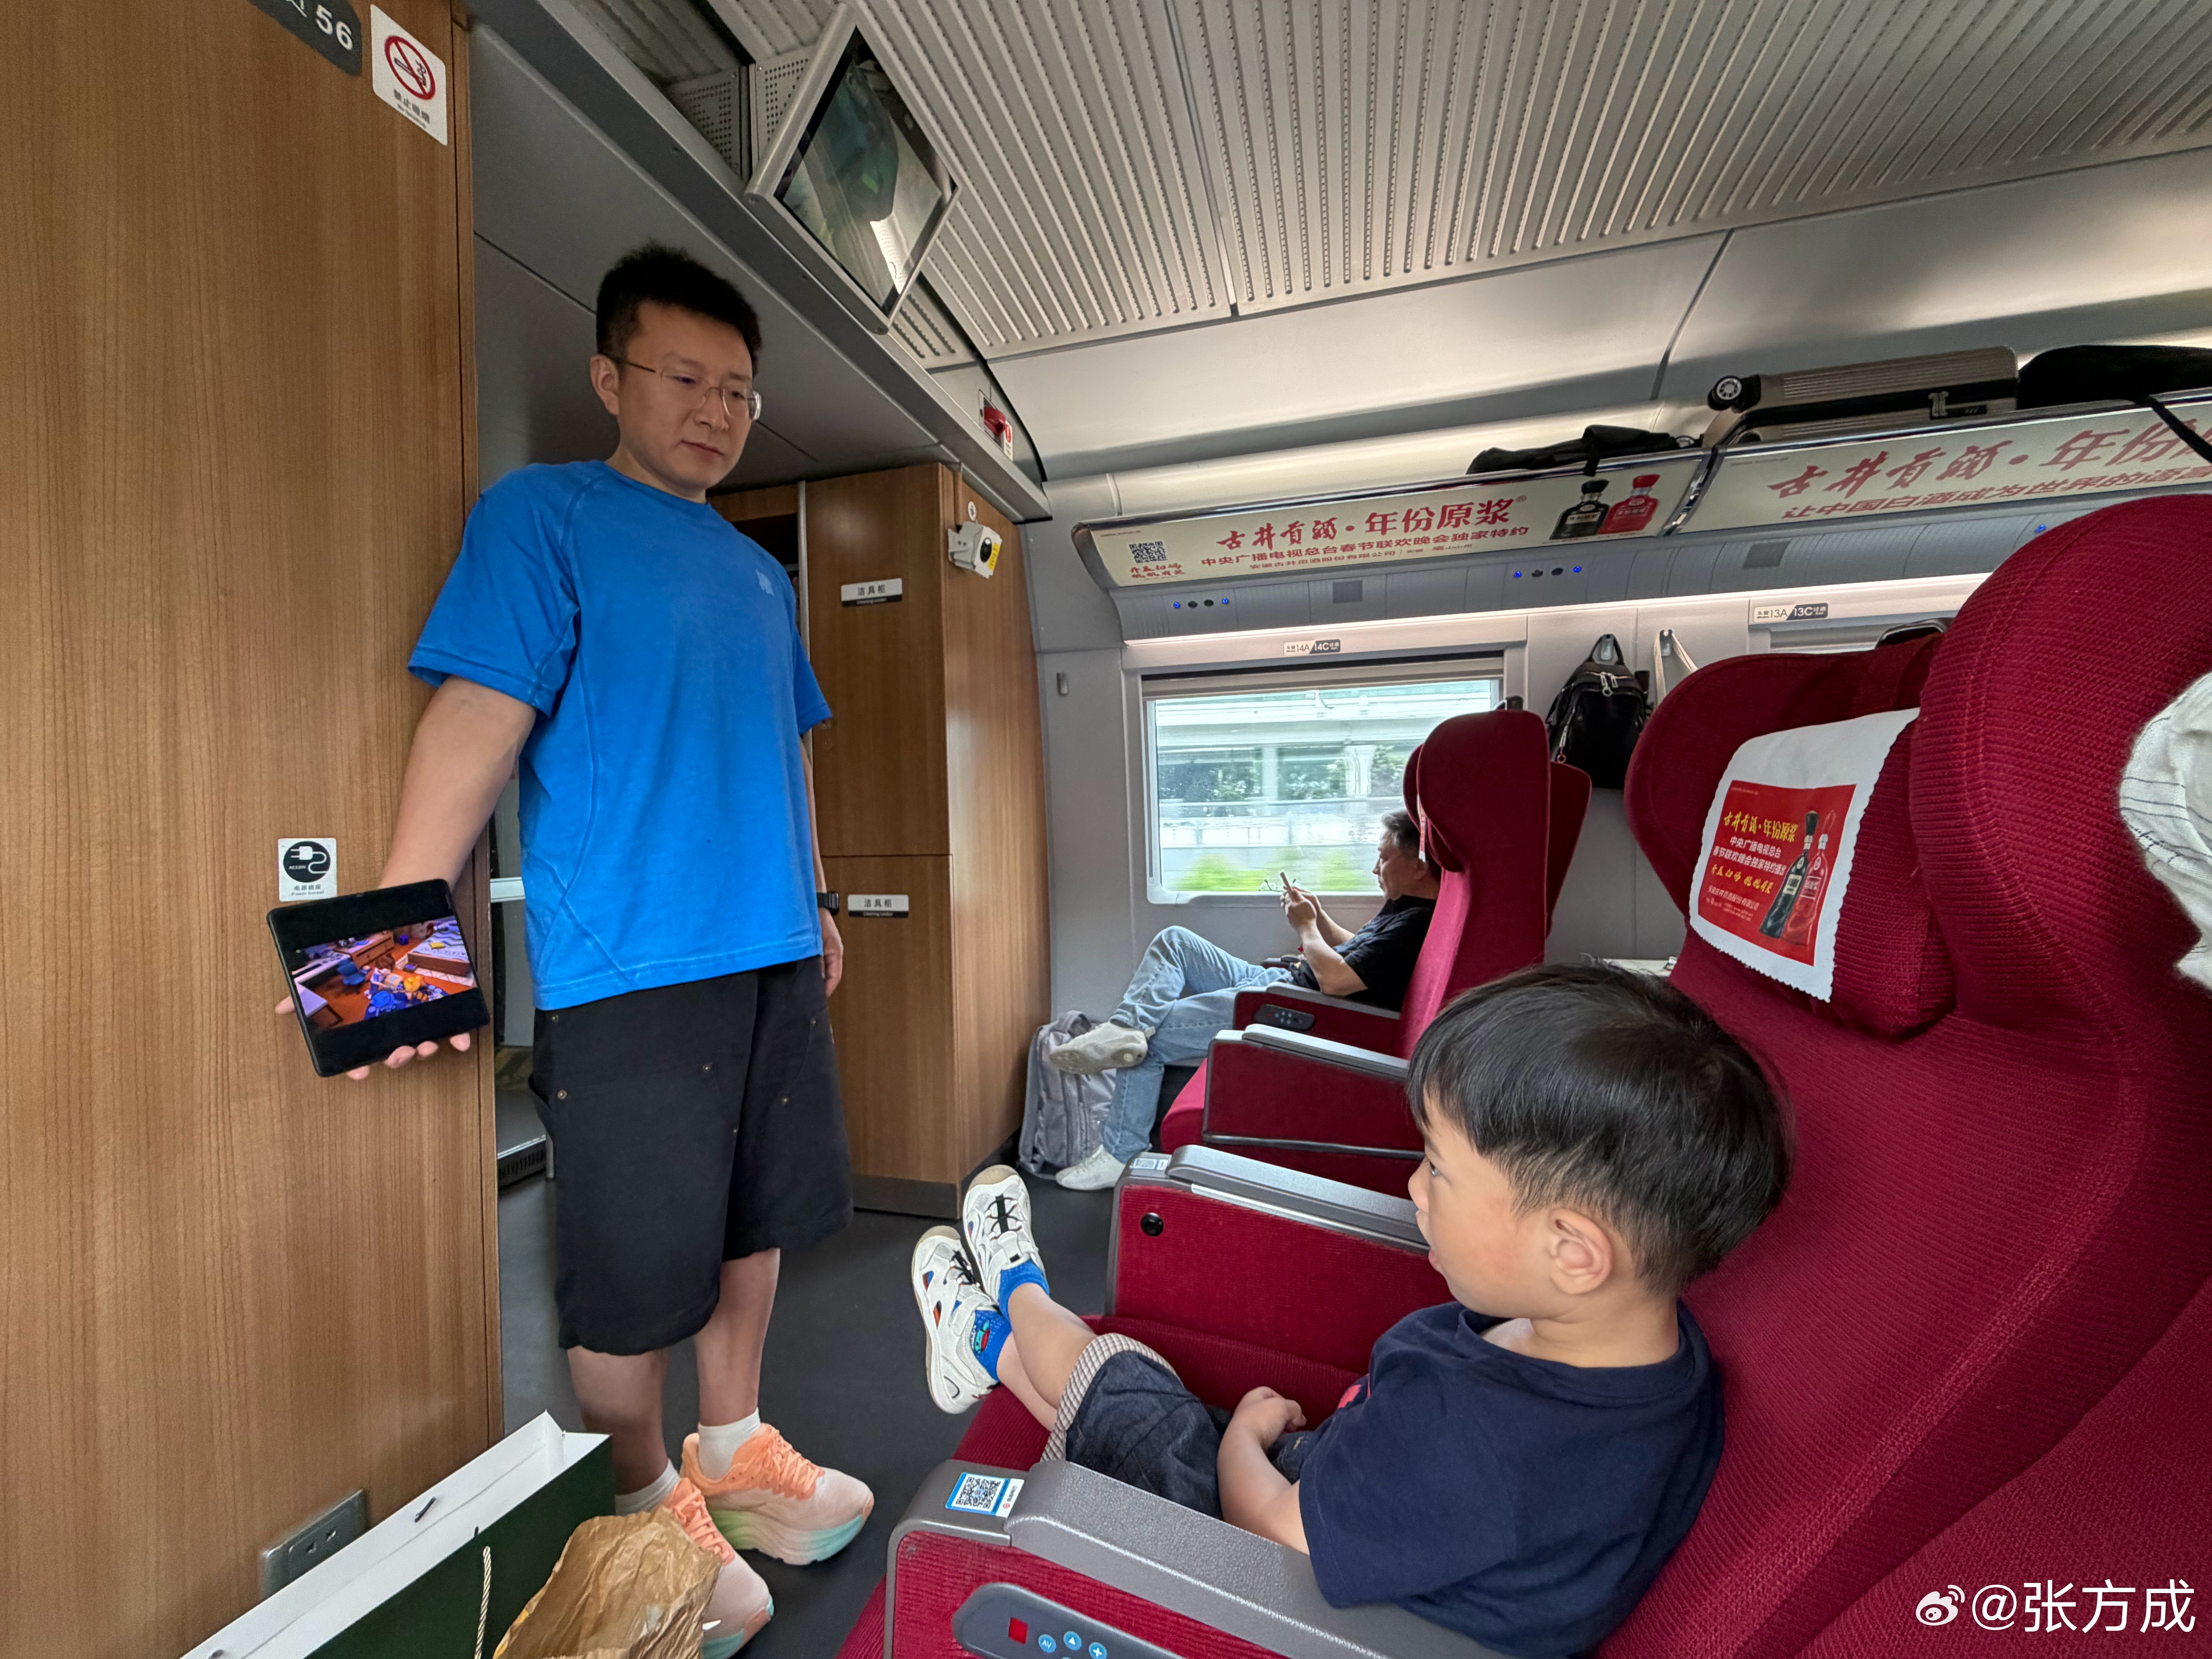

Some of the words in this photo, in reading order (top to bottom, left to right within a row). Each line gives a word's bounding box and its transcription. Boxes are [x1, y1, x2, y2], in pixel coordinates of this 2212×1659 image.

[316, 4, 353, 50] 56
[1767, 418, 2212, 499] 古井贡酒·年份
[1201, 527, 1529, 566] 中央广播电视总台春节联欢晚会独家特约
[1771, 609, 1788, 618] 13A
[1794, 607, 1813, 617] 13C
[1297, 644, 1310, 652] 14A
[1314, 642, 1329, 651] 14C
[1729, 835, 1782, 859] 中央广播电视总台
[864, 898, 892, 908] 洁具柜
